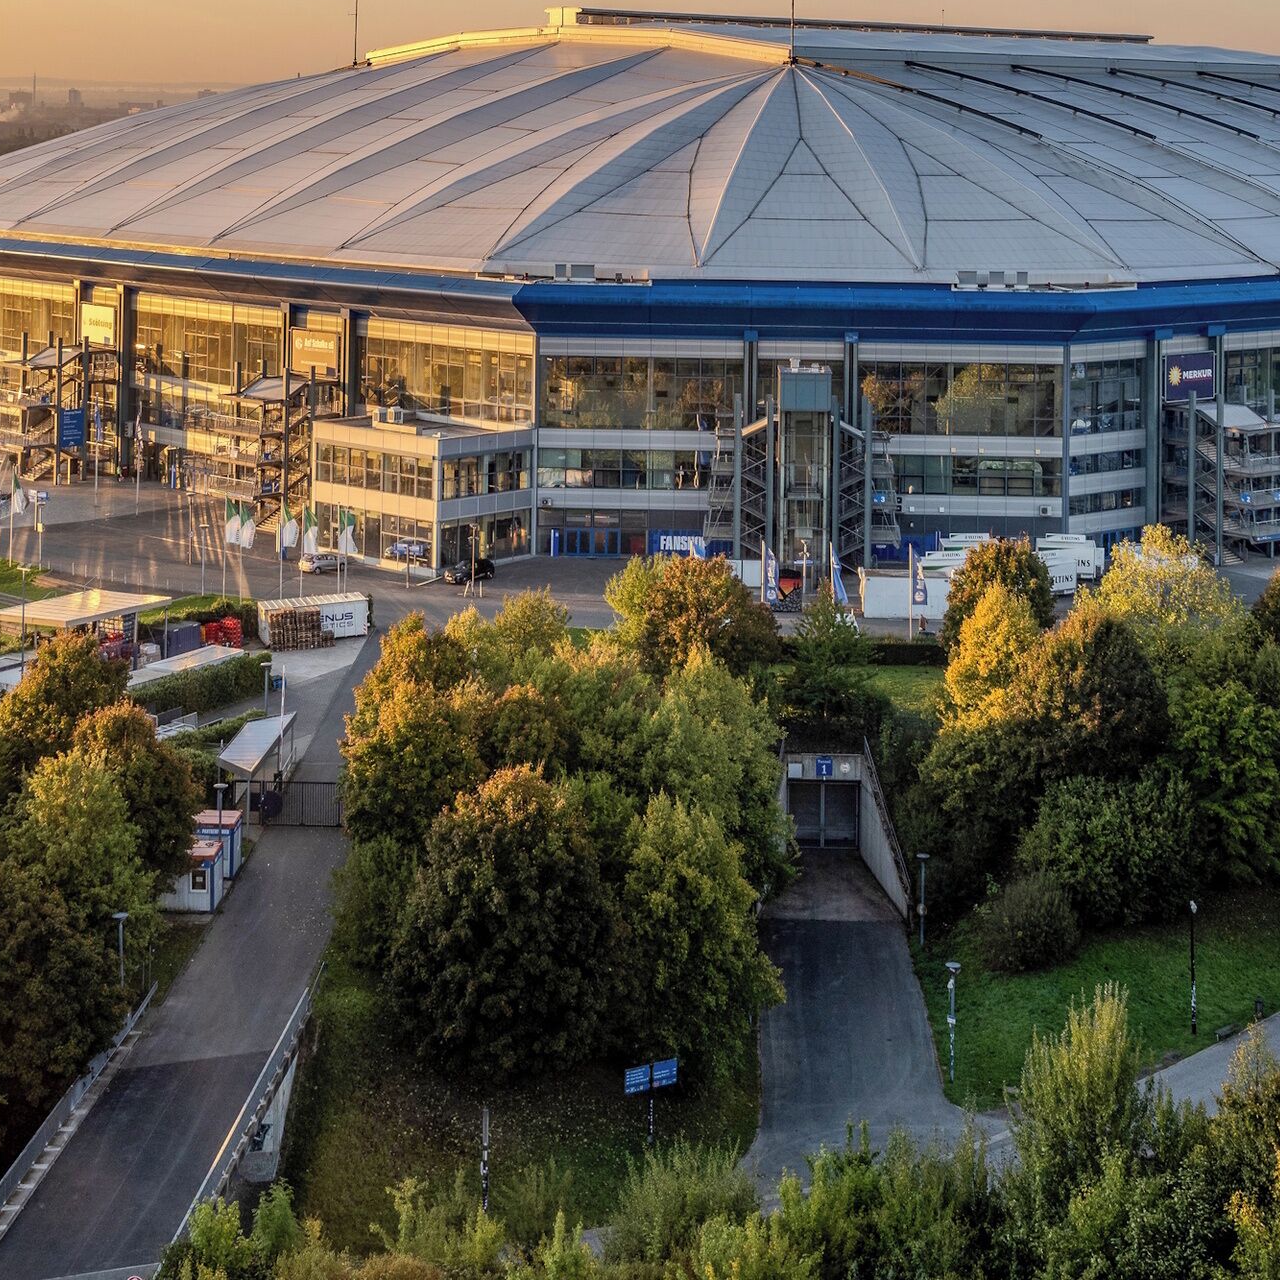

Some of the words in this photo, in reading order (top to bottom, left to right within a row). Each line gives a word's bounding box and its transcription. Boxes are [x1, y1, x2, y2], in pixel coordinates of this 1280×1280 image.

[1182, 369, 1212, 379] MERKUR
[660, 535, 705, 551] FANSHO
[821, 764, 827, 774] 1
